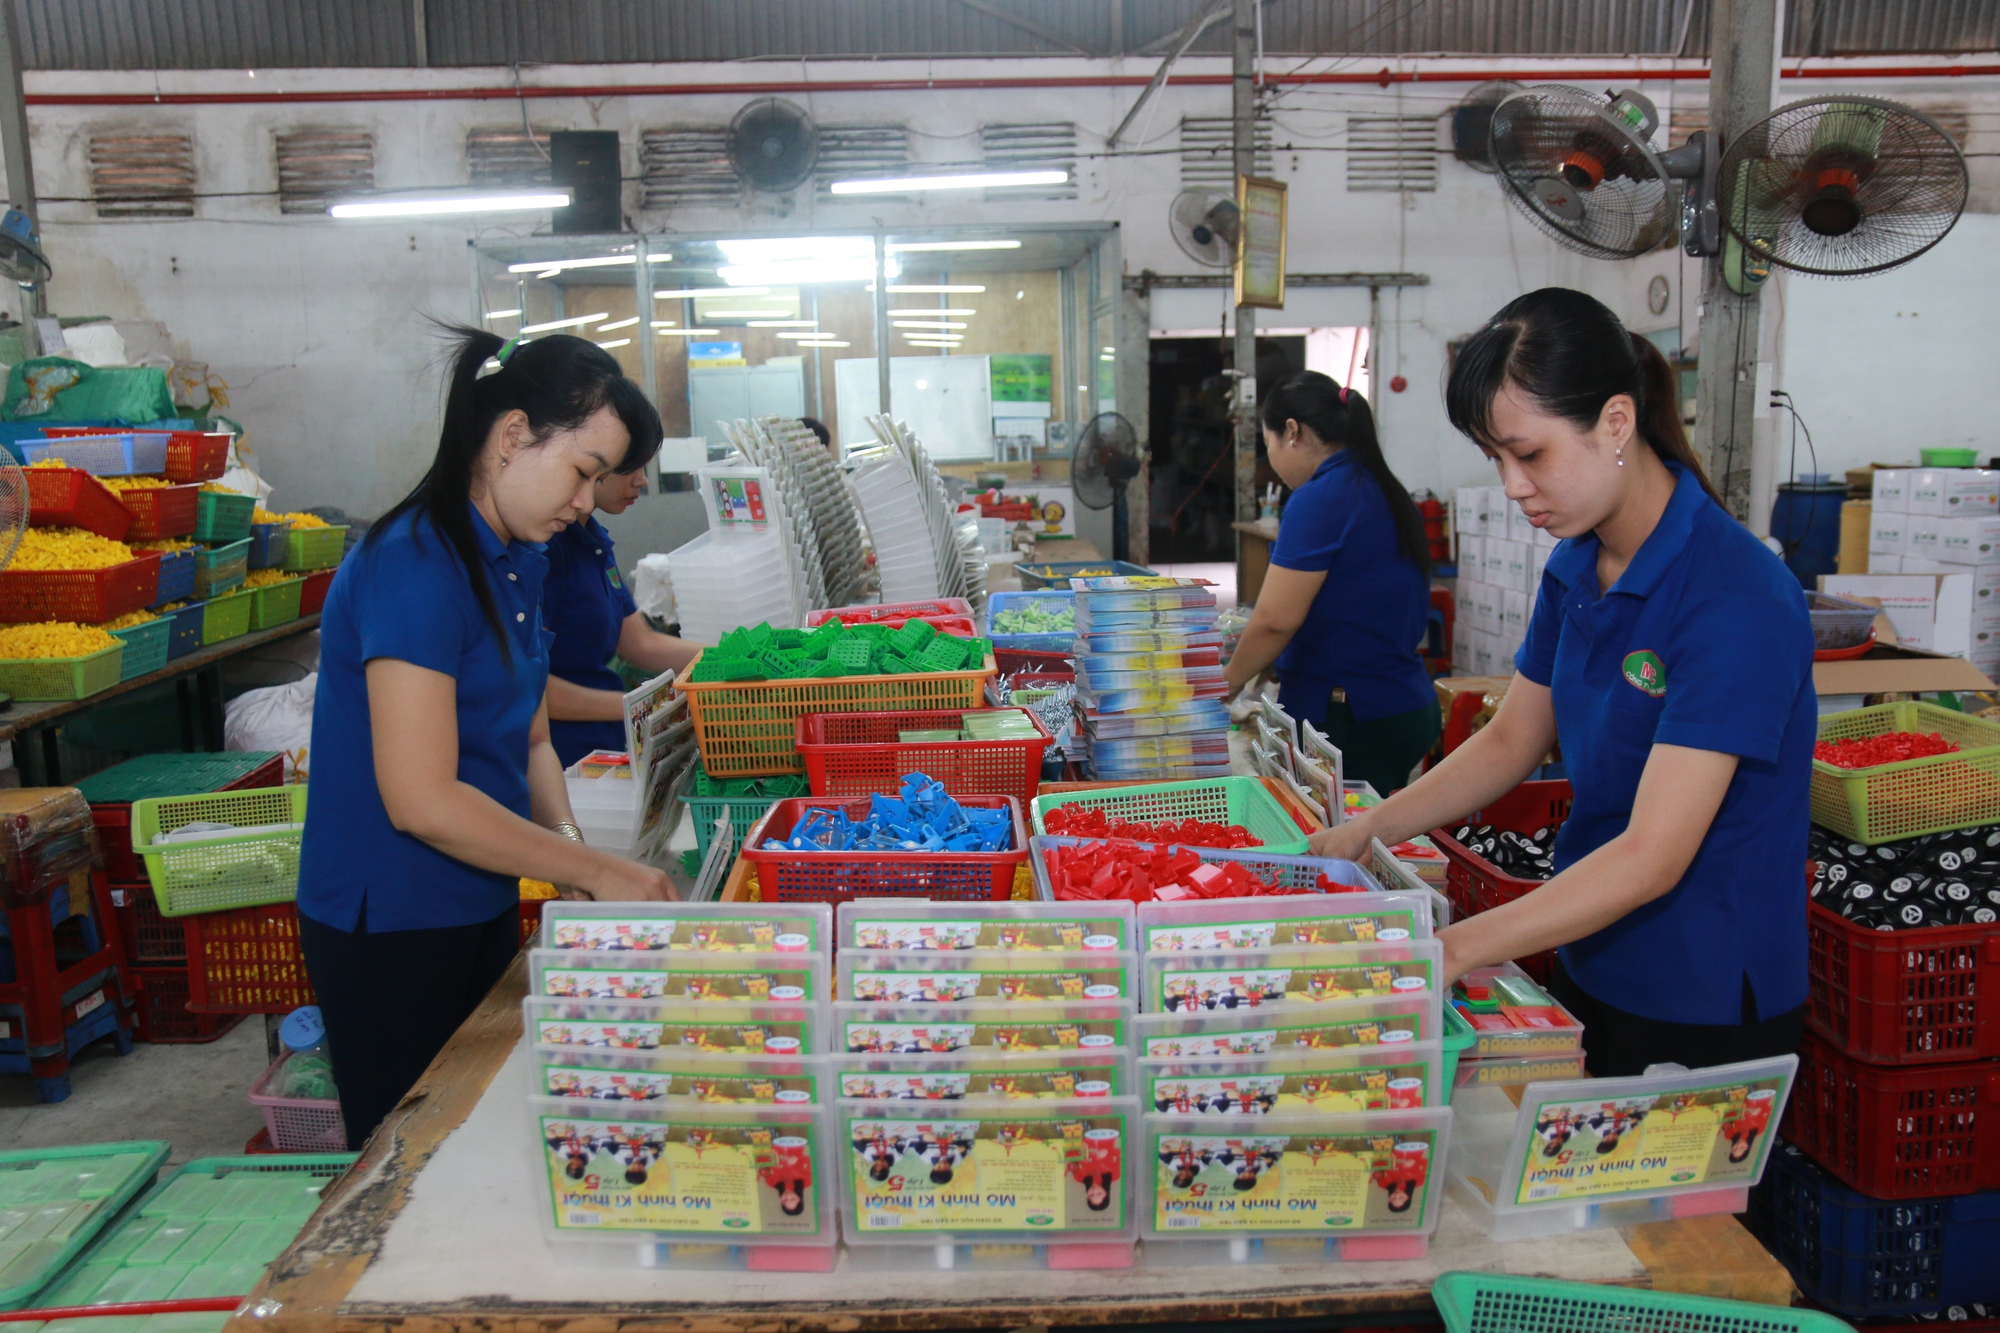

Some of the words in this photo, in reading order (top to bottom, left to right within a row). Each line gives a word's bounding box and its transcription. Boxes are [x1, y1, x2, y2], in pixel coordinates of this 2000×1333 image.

[1626, 671, 1642, 686] CÔNG
[1555, 1150, 1574, 1165] 5
[1640, 1156, 1667, 1170] Mô
[1600, 1159, 1635, 1174] hình
[1530, 1167, 1574, 1182] thuật
[584, 1174, 601, 1190] 5
[888, 1175, 905, 1191] 5
[1190, 1183, 1208, 1197] 5
[564, 1191, 610, 1207] thuật
[638, 1195, 676, 1208] hình
[683, 1196, 711, 1210] Mô
[865, 1193, 913, 1208] thuật
[942, 1194, 980, 1208] hình
[987, 1194, 1016, 1208] Mô
[1165, 1199, 1213, 1212] thuật
[1242, 1199, 1281, 1211] hình
[1287, 1199, 1317, 1211] Mô
